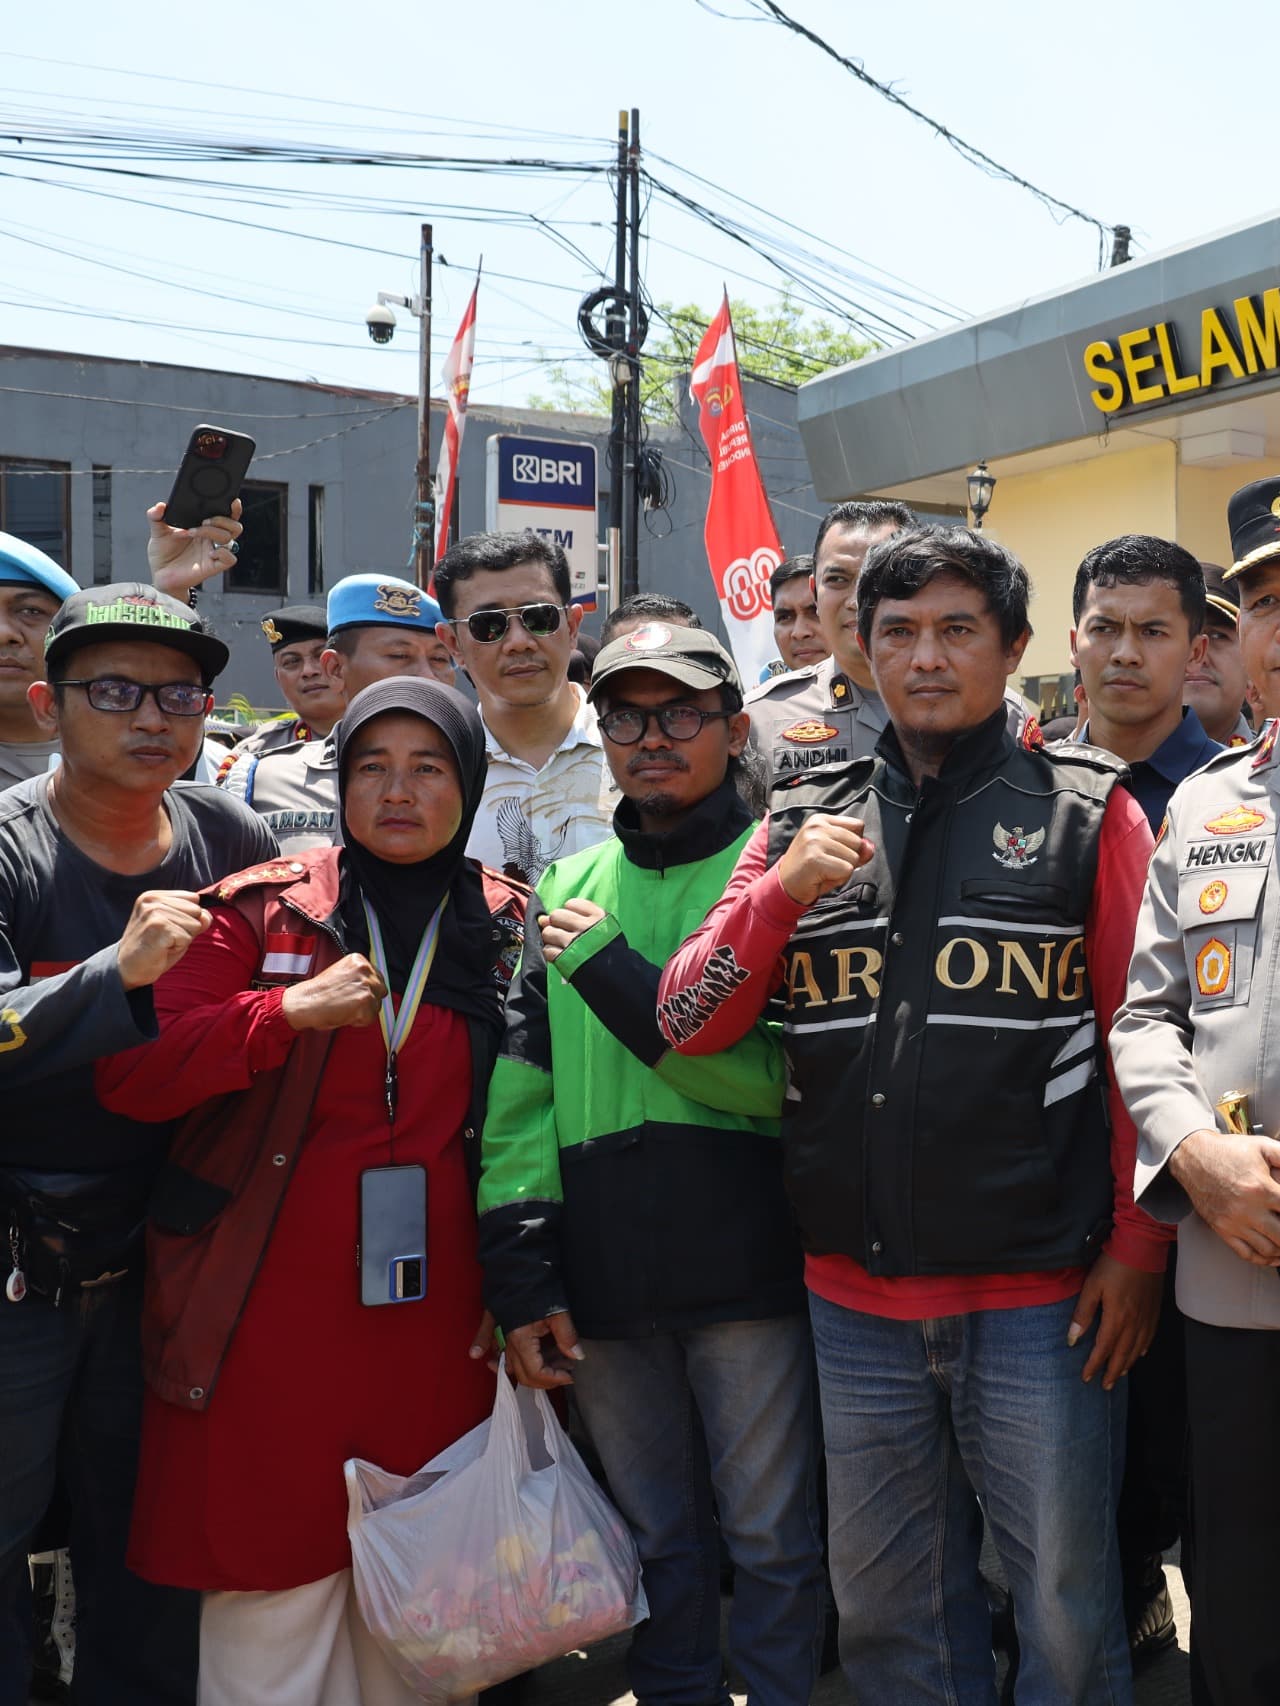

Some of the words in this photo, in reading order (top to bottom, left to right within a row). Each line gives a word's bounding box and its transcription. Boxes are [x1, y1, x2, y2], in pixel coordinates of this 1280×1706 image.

[541, 459, 582, 485] BRI
[525, 527, 573, 549] TM
[779, 747, 848, 769] ANDHI
[263, 811, 335, 829] AMDAN
[1186, 839, 1266, 868] HENGKI
